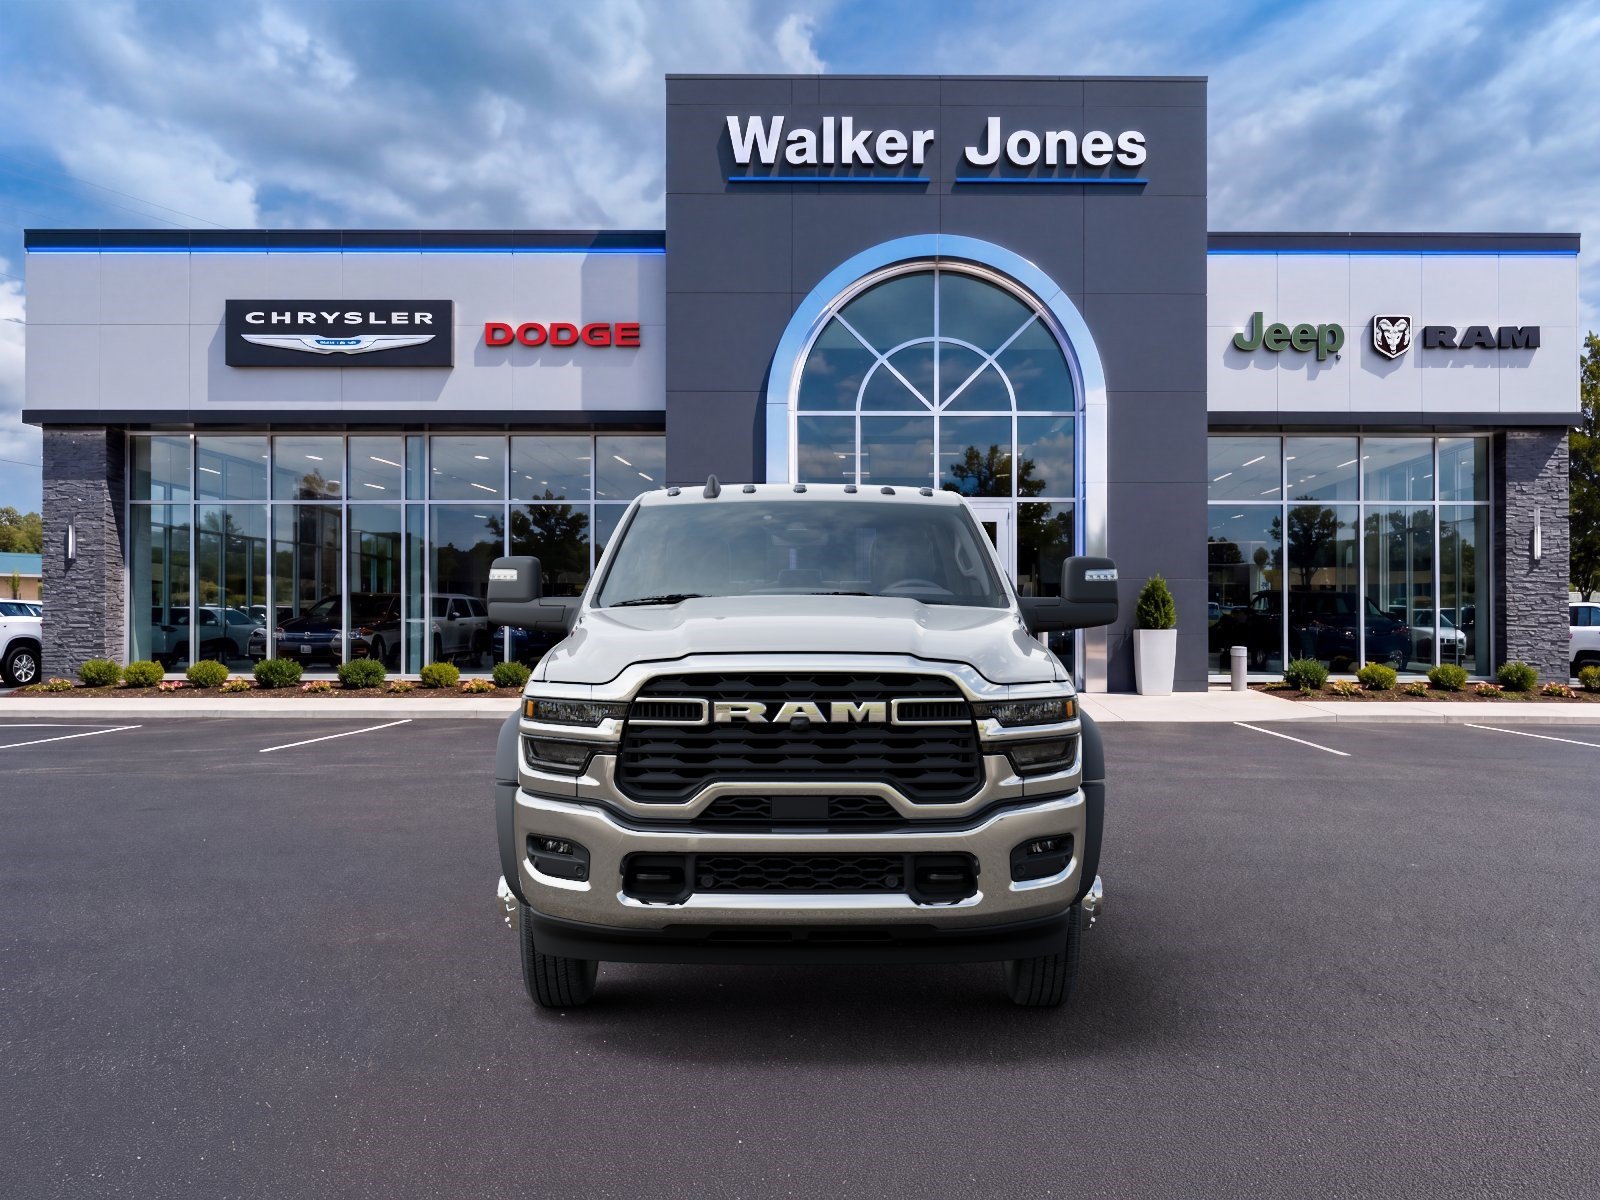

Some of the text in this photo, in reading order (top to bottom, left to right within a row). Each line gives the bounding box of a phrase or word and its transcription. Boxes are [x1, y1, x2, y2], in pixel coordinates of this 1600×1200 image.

[726, 115, 1148, 167] Walker Jones
[245, 311, 434, 325] CHRYSLER
[484, 322, 641, 347] DODGE
[1233, 311, 1345, 361] Jeep
[1423, 325, 1541, 349] RAM
[713, 701, 887, 723] RAM
